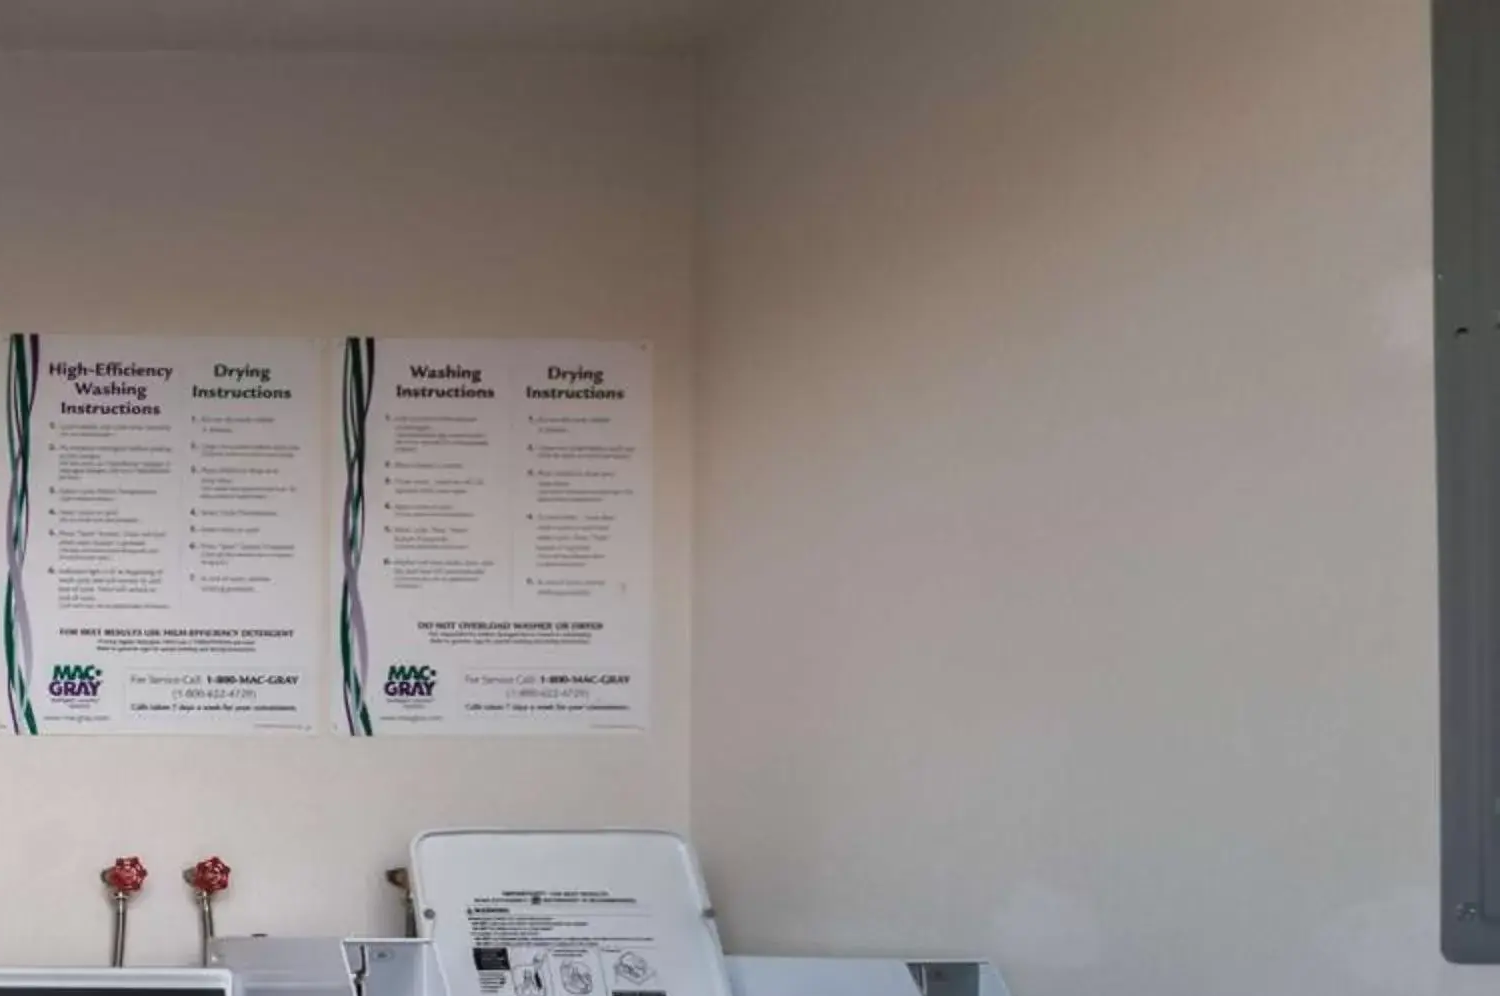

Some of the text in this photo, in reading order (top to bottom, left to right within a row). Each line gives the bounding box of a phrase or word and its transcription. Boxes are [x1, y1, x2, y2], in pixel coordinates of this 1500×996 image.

[49, 362, 174, 381] High-Efficiency
[213, 363, 271, 382] Drying
[410, 365, 482, 383] Washing
[547, 366, 604, 384] Drying
[74, 382, 147, 400] Washing
[192, 385, 292, 400] Instructions
[395, 384, 495, 400] Instructions
[526, 385, 625, 401] Instructions
[60, 401, 161, 417] Instructions
[49, 680, 101, 697] GRAY
[384, 680, 436, 697] GRAY
